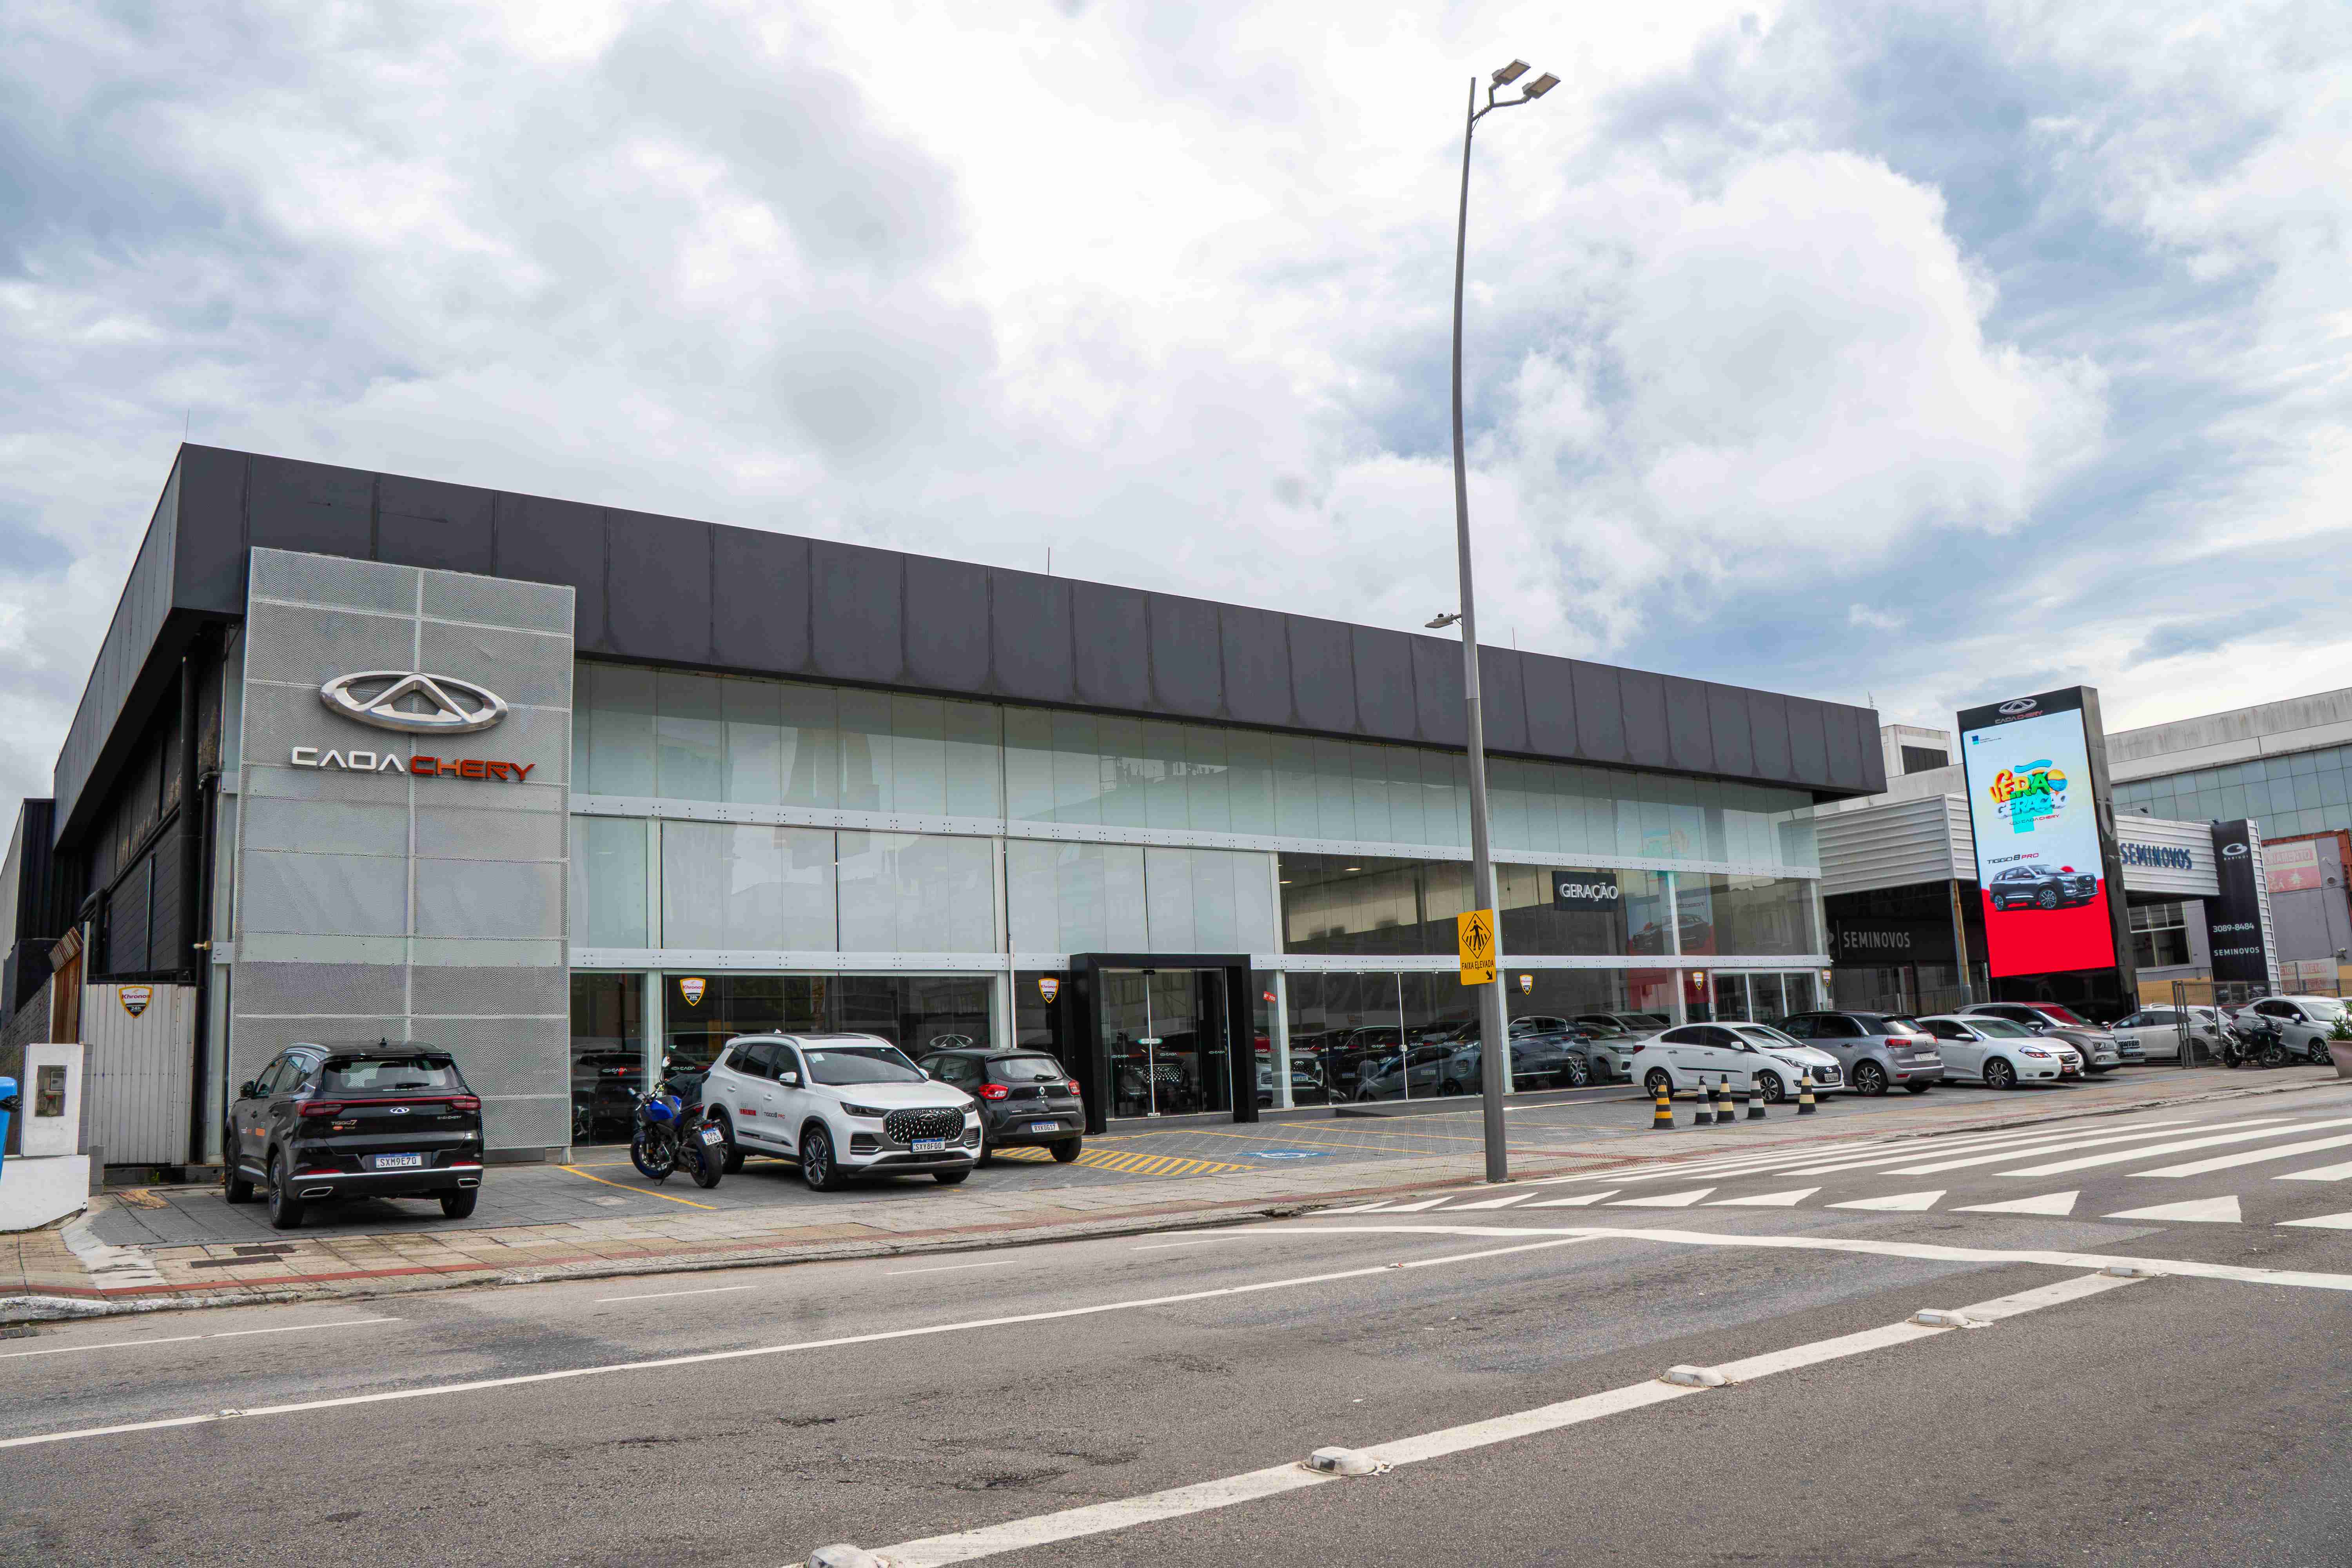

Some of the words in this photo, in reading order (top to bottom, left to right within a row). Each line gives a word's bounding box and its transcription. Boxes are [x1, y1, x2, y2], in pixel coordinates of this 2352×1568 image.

[410, 755, 535, 780] CHERY
[2120, 843, 2192, 870] SEMINOVOS
[1559, 882, 1619, 902] GERAÇÃO
[2213, 923, 2255, 933] 3089-8484
[1844, 931, 1911, 948] SEMINOVOS
[2214, 947, 2260, 956] SEMINOVOS
[1461, 962, 1474, 970] FAIXA
[1475, 959, 1494, 969] ELEVADA
